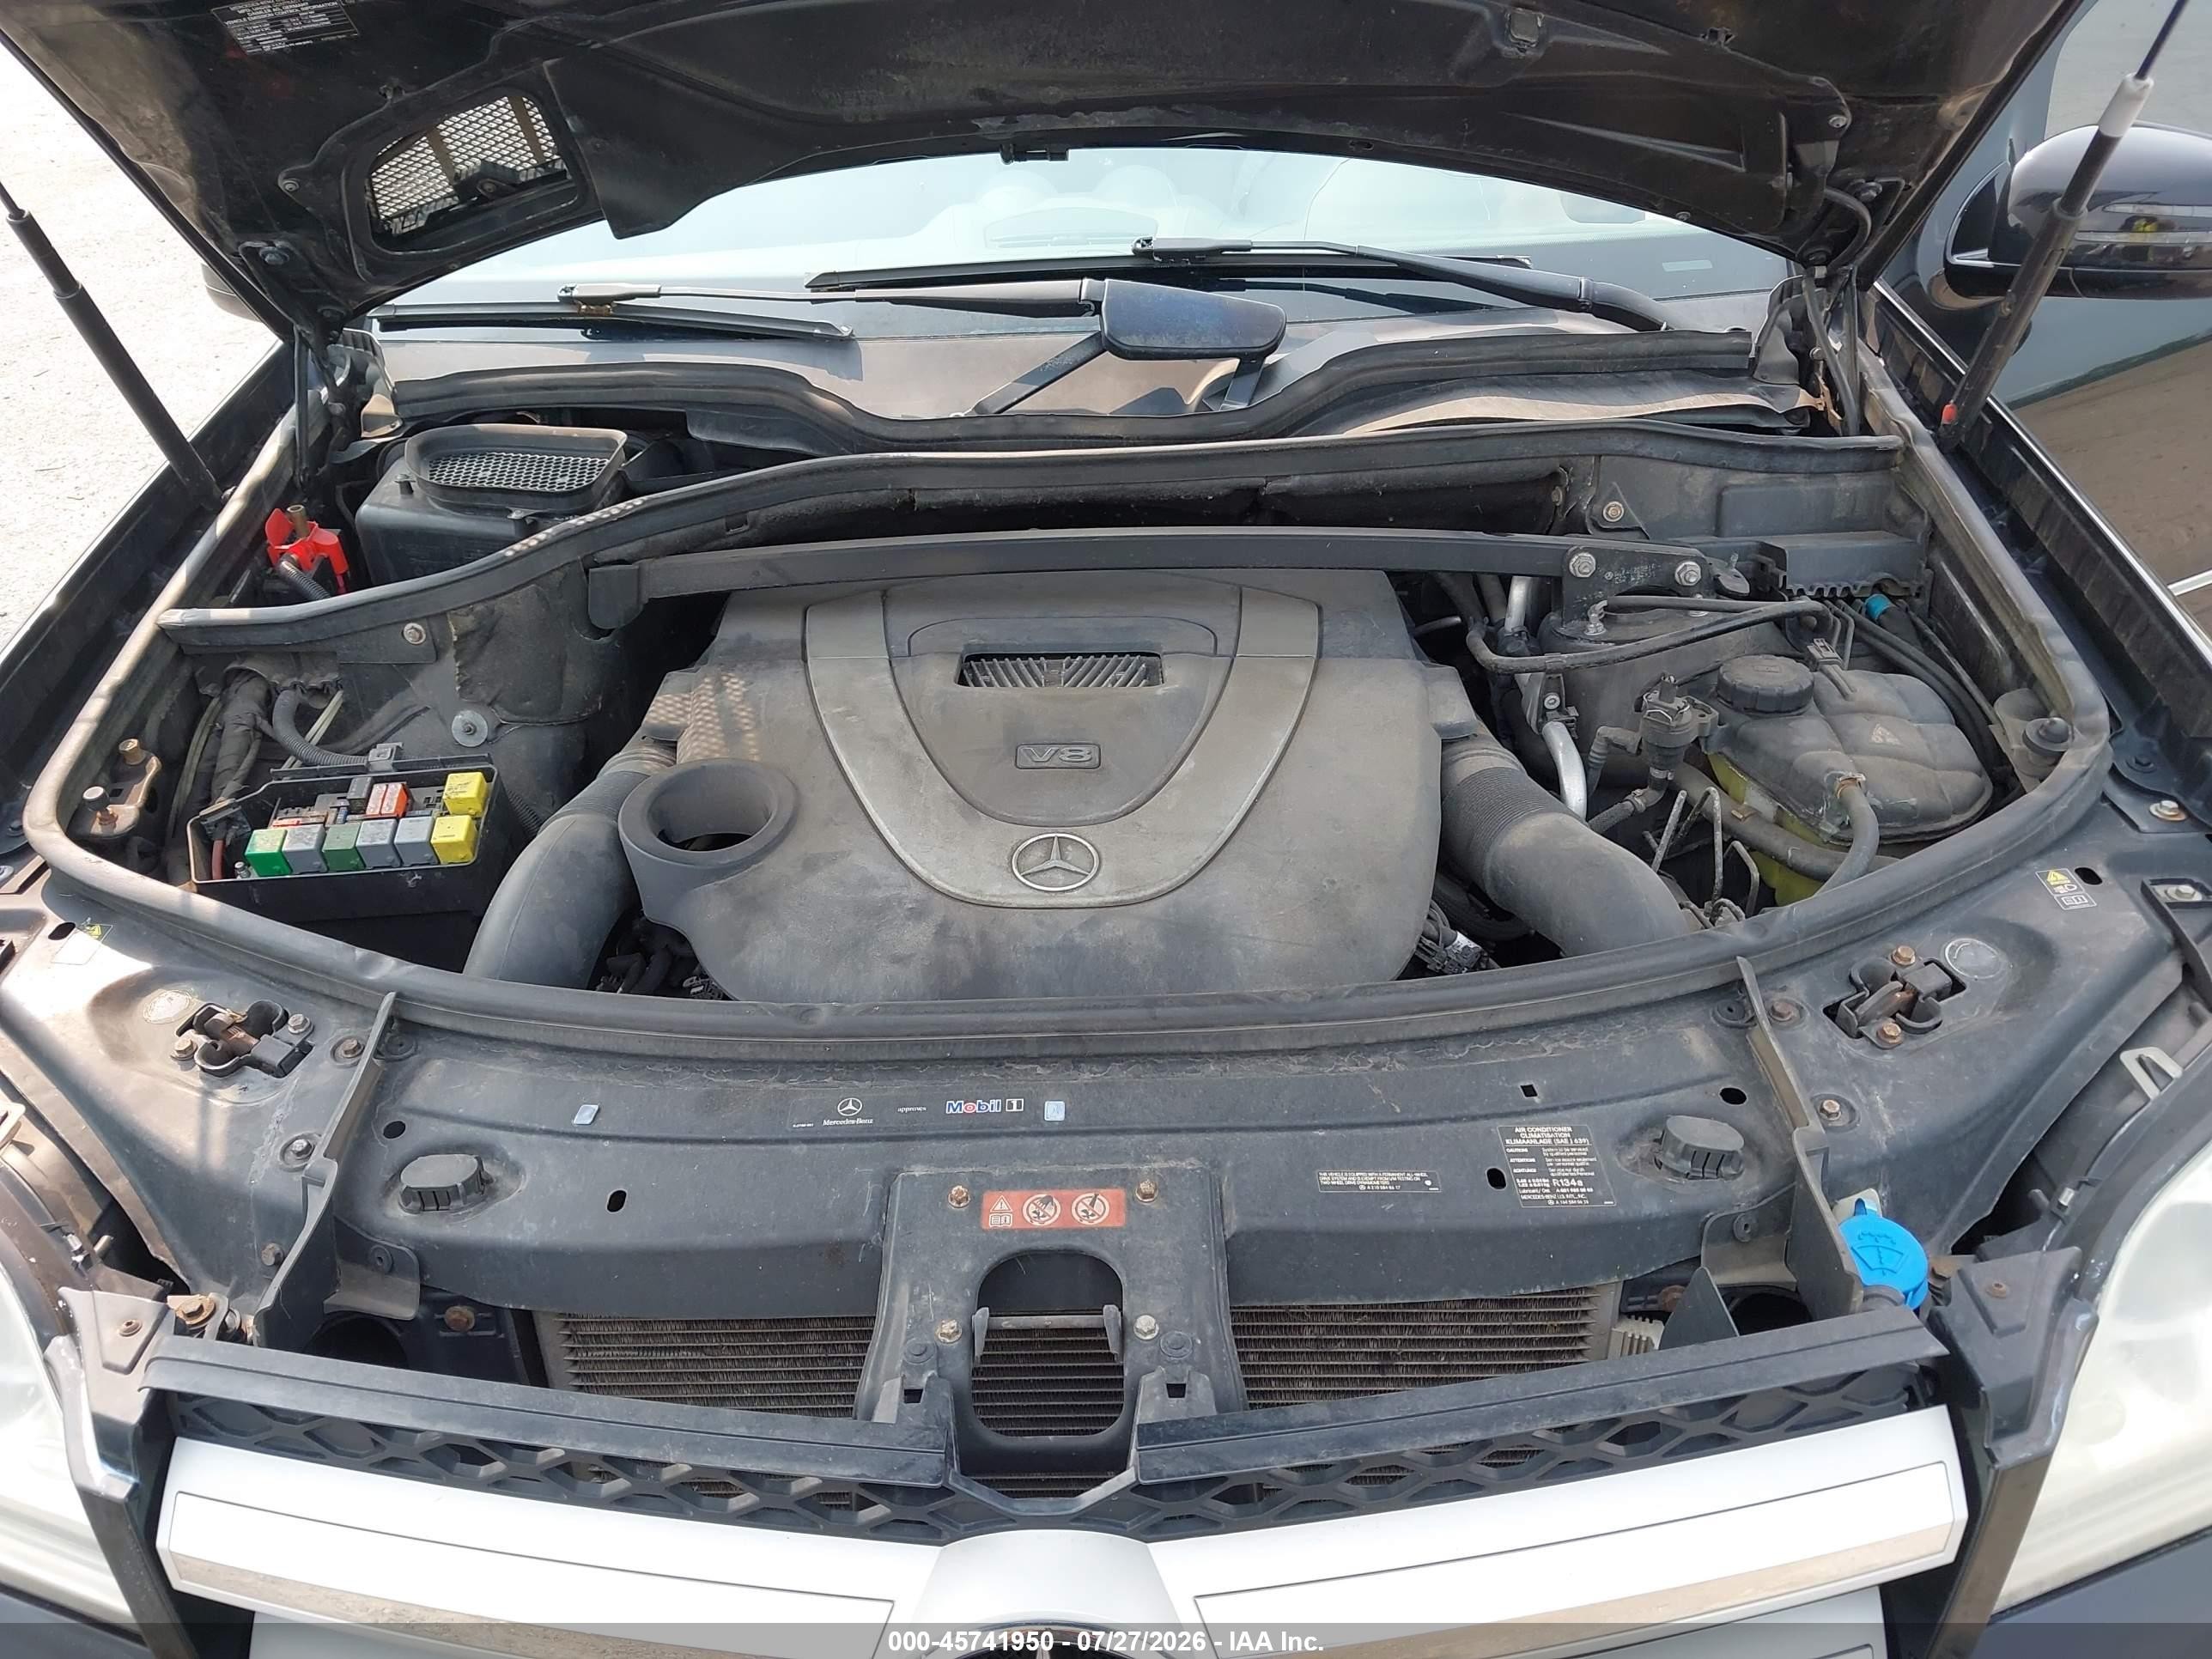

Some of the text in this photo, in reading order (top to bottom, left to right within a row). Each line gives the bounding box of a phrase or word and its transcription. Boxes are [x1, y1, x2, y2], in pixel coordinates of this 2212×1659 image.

[1021, 746, 1093, 763] V8
[897, 1105, 927, 1114] approves
[945, 1099, 1001, 1114] Mobil
[1552, 1178, 1583, 1187] R134a
